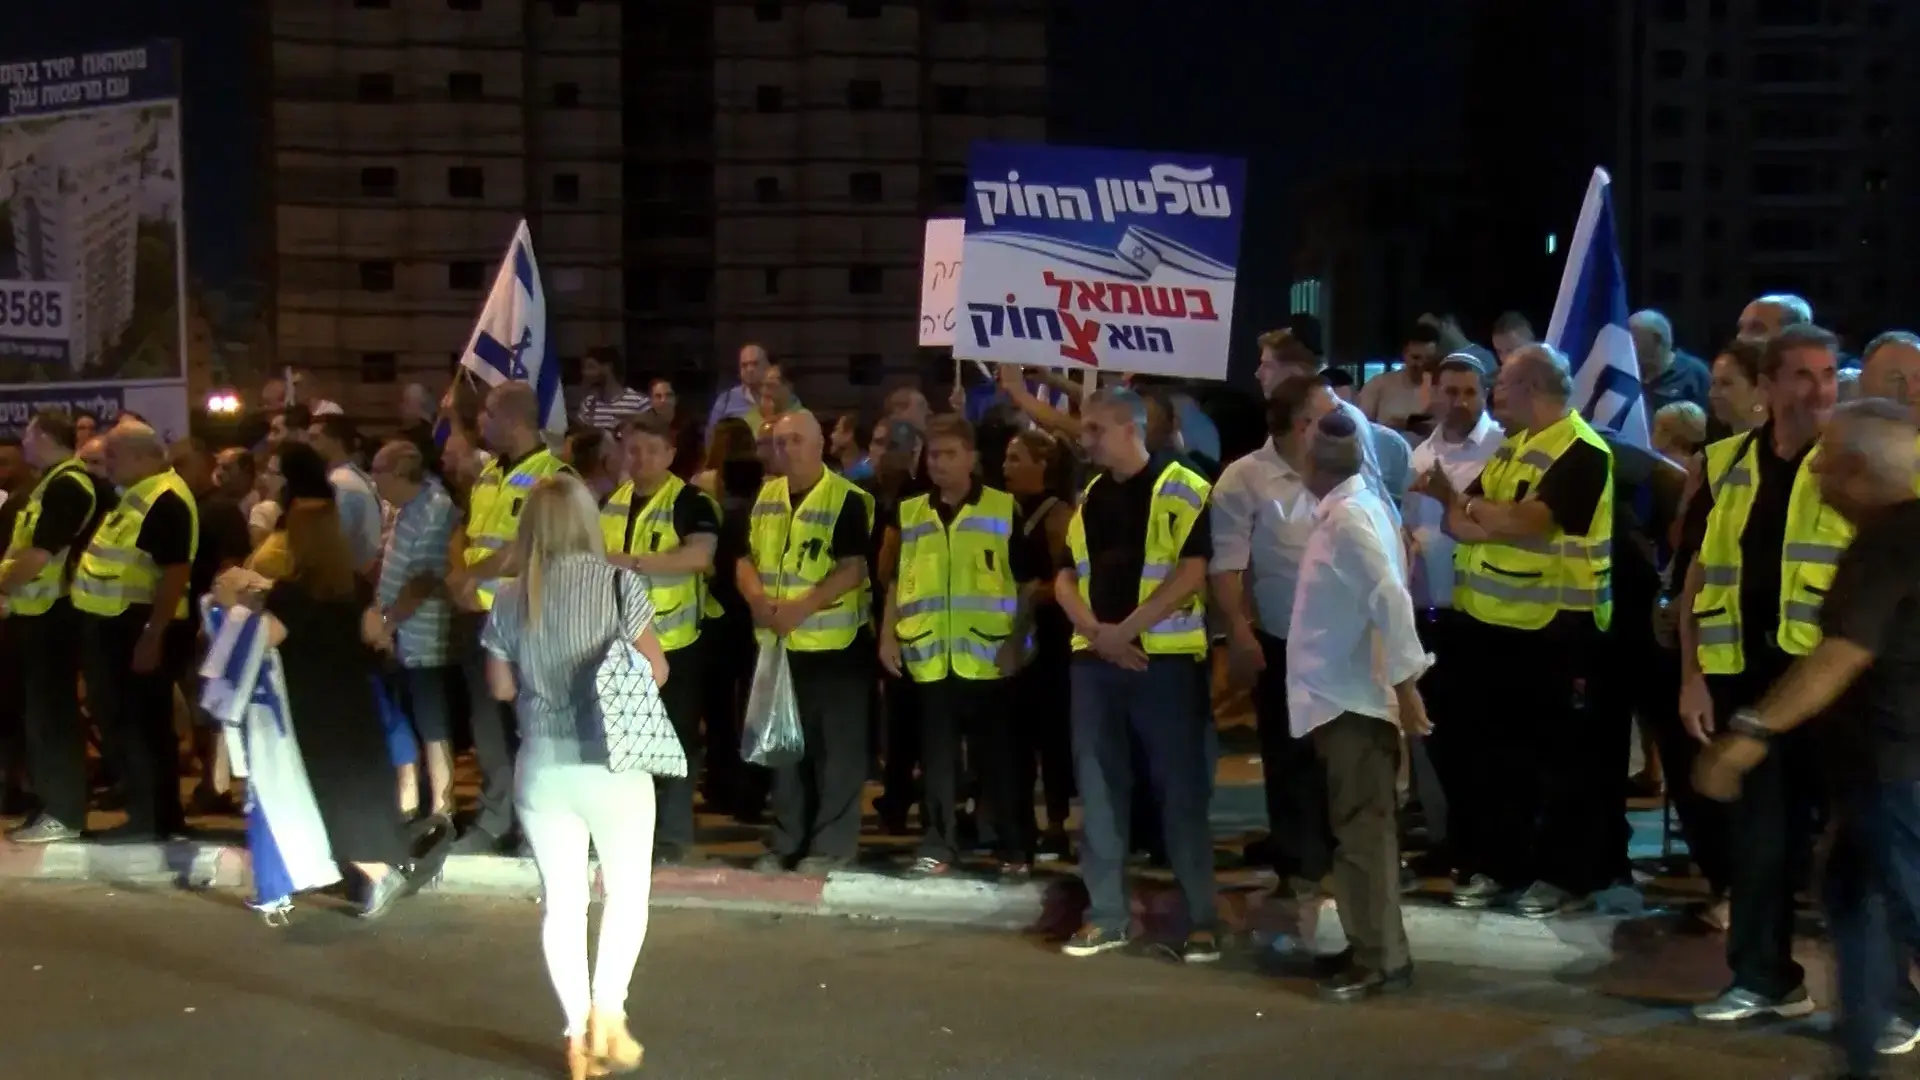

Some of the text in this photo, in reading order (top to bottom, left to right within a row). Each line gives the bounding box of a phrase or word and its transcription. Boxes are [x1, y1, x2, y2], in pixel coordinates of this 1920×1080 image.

[1095, 164, 1231, 224] שלטון
[1042, 270, 1219, 320] בשמאל
[1105, 322, 1175, 353] הוא
